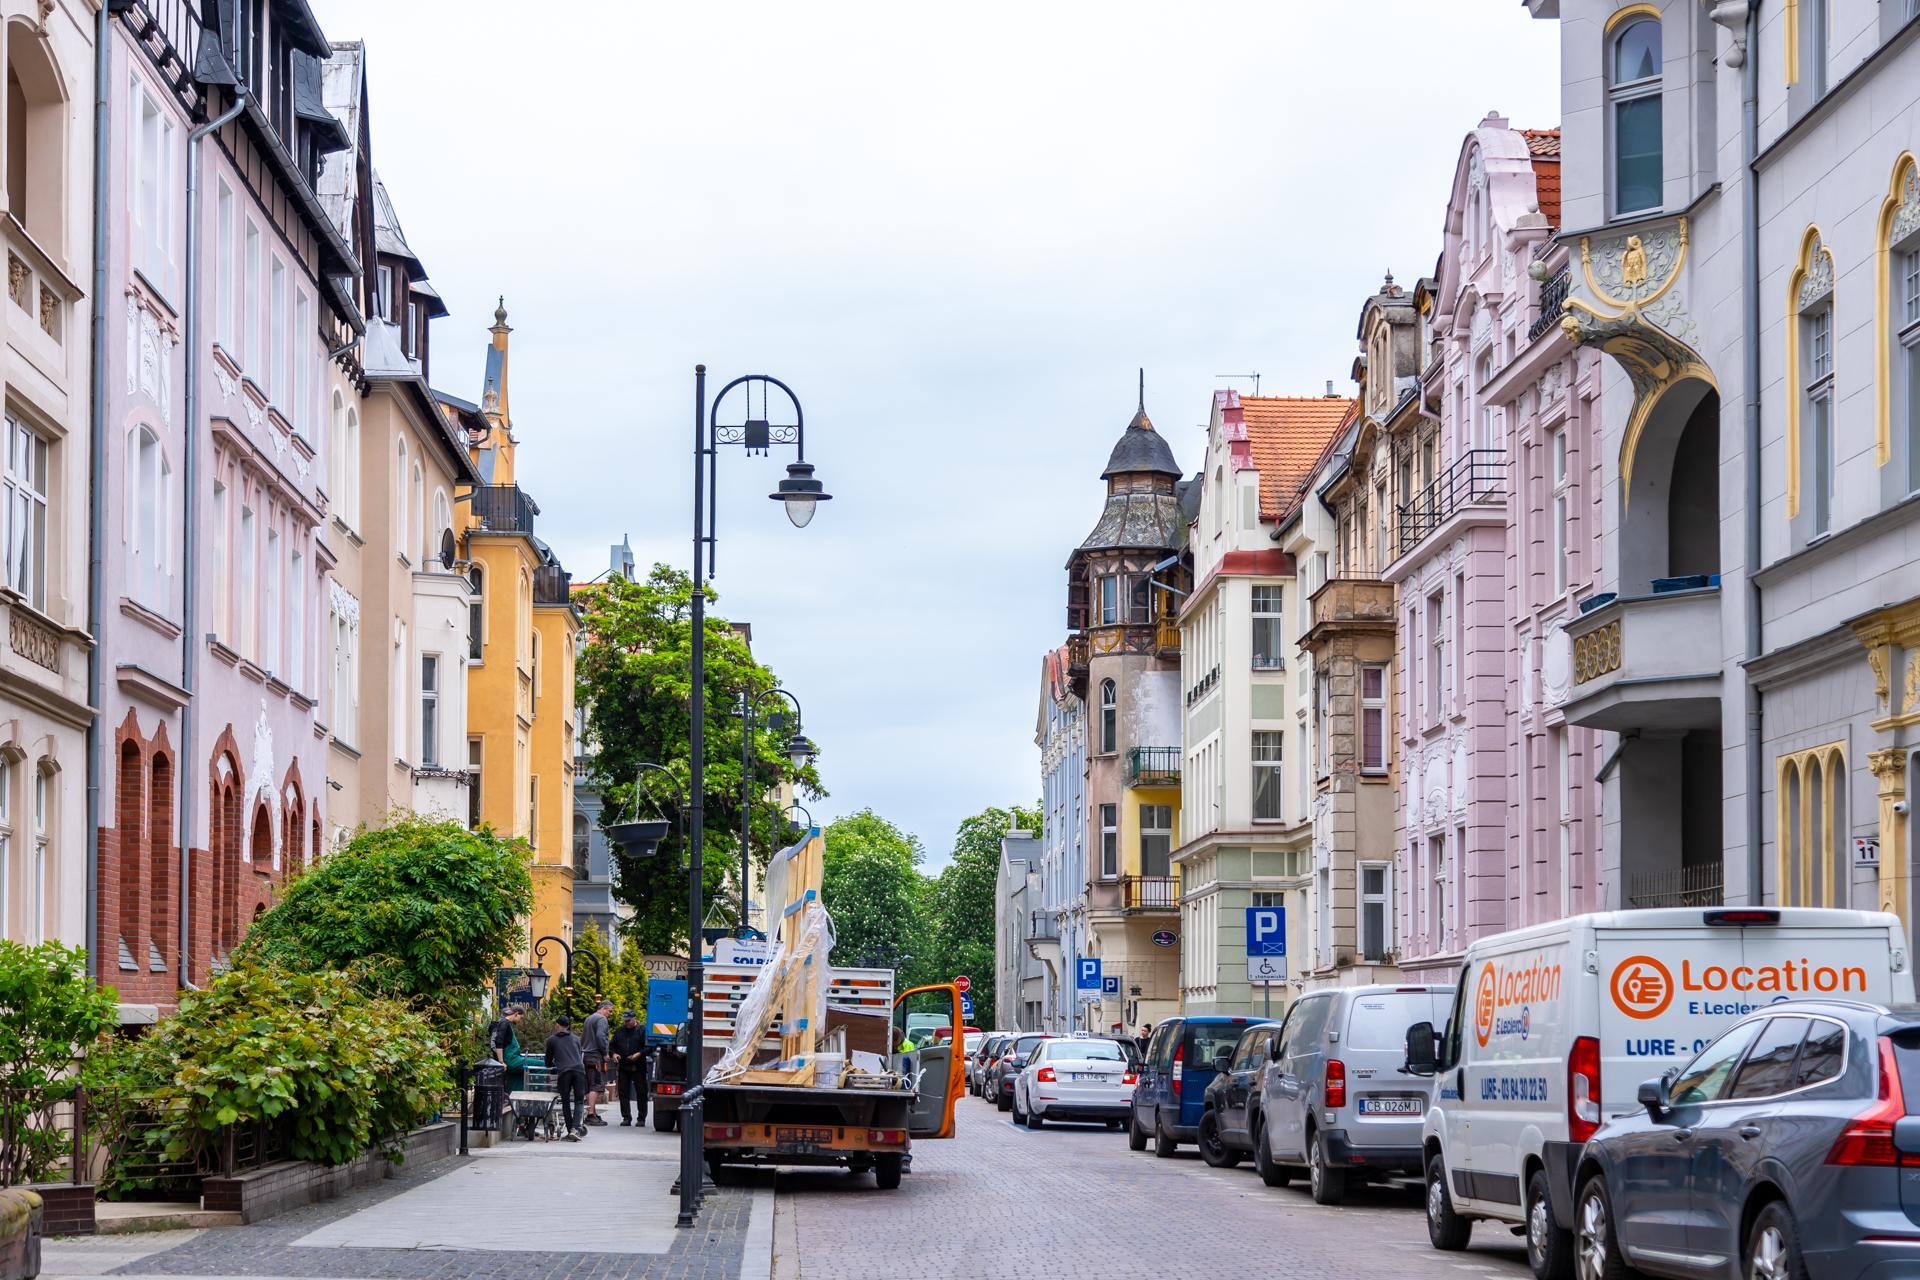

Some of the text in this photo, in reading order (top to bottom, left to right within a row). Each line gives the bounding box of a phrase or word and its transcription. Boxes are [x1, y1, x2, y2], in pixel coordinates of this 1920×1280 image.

[1859, 846, 1874, 859] 11
[1255, 911, 1278, 942] P
[1082, 961, 1096, 980] P
[1682, 958, 1867, 993] Location
[1106, 979, 1115, 991] P
[1498, 953, 1561, 1007] Location
[1689, 1001, 1765, 1015] E.Lecler
[1626, 1039, 1676, 1056] LURE
[1693, 1039, 1712, 1055] 0
[1481, 1078, 1497, 1100] LURE
[1501, 1078, 1509, 1100] 03
[1510, 1078, 1518, 1100] 84
[1519, 1078, 1527, 1100] 30
[1529, 1078, 1537, 1100] 22
[1538, 1078, 1547, 1101] 50
[1367, 1101, 1417, 1112] CB 026MJ
